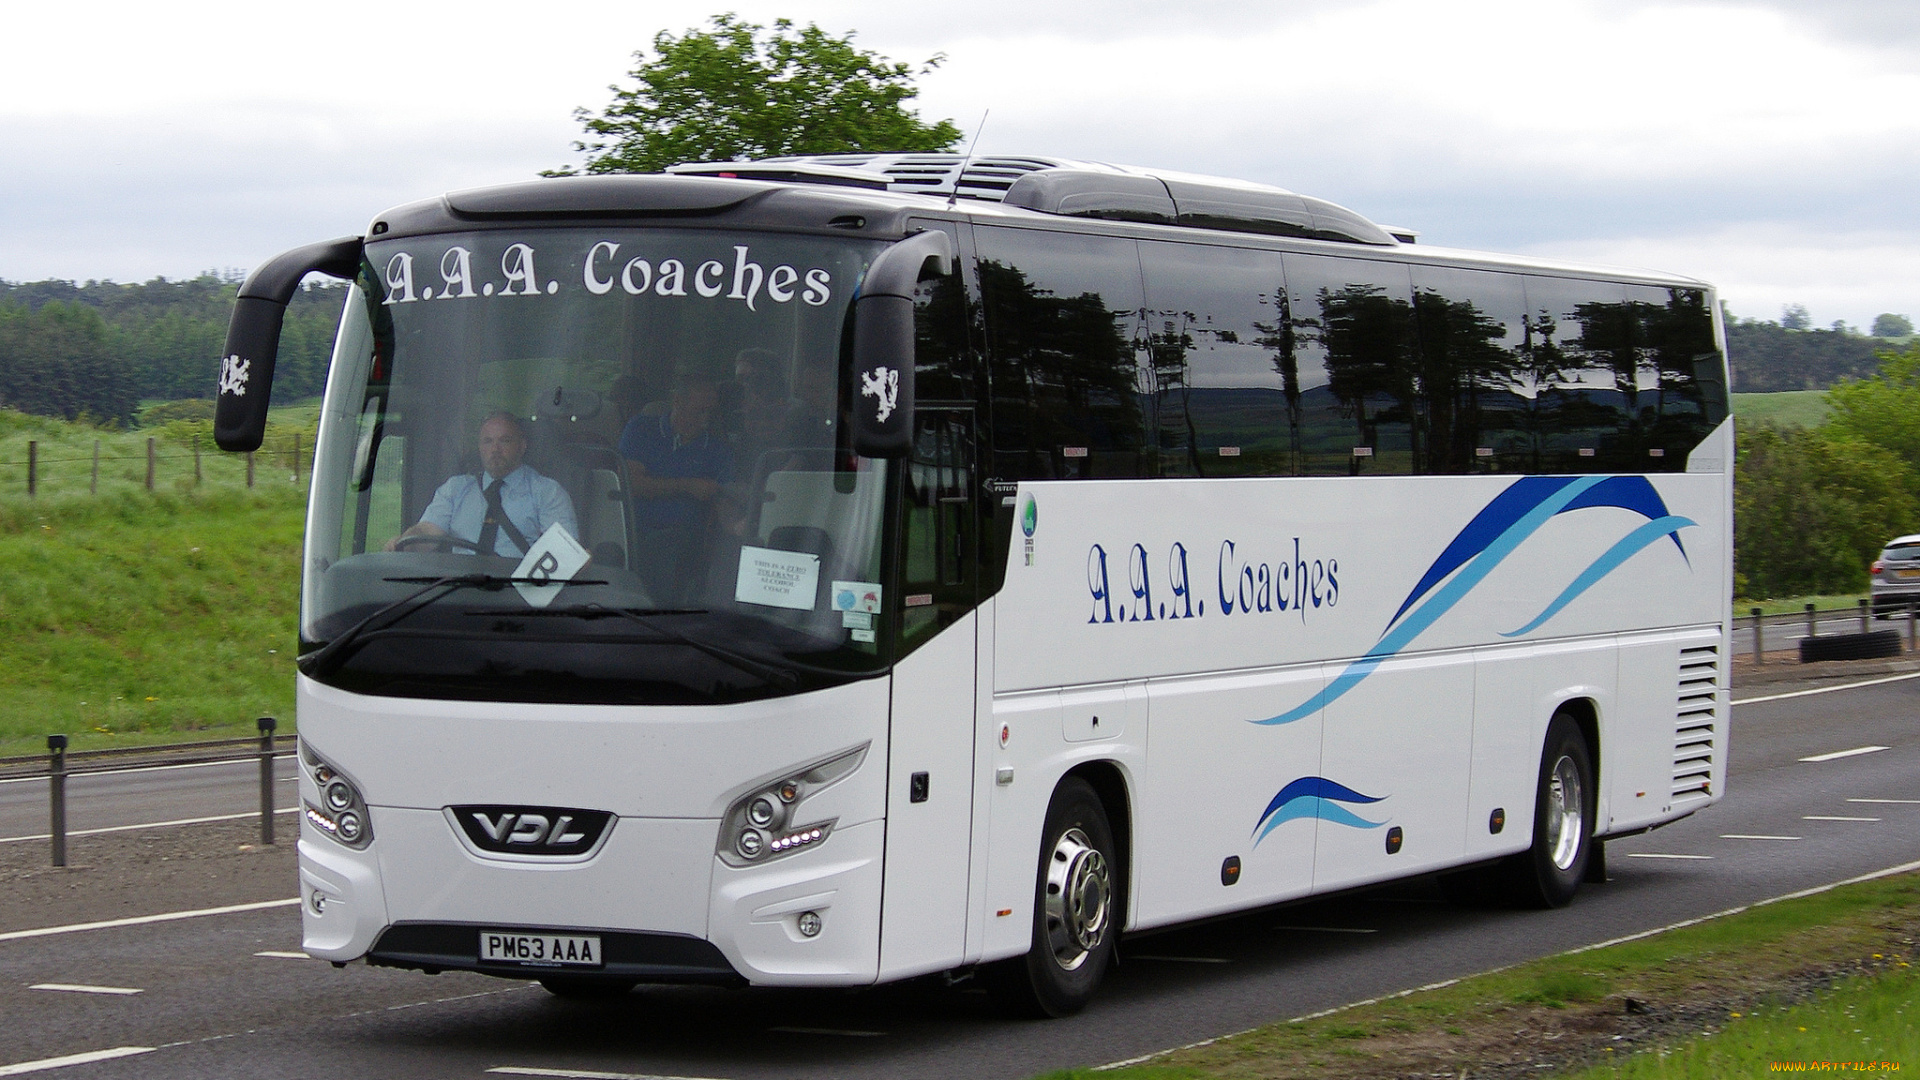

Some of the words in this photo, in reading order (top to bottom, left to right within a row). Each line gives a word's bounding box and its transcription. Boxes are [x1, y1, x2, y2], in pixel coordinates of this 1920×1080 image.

[381, 243, 560, 305] A.A.A.
[584, 240, 832, 312] Coaches
[757, 569, 800, 581] TOLERANCE
[761, 577, 795, 587] ALCOHOL
[1087, 541, 1204, 624] A.A.A.
[1218, 537, 1339, 626] Coaches
[763, 585, 790, 594] COACH
[472, 812, 586, 846] VDL
[489, 936, 544, 959] PM63
[552, 938, 592, 961] AAA
